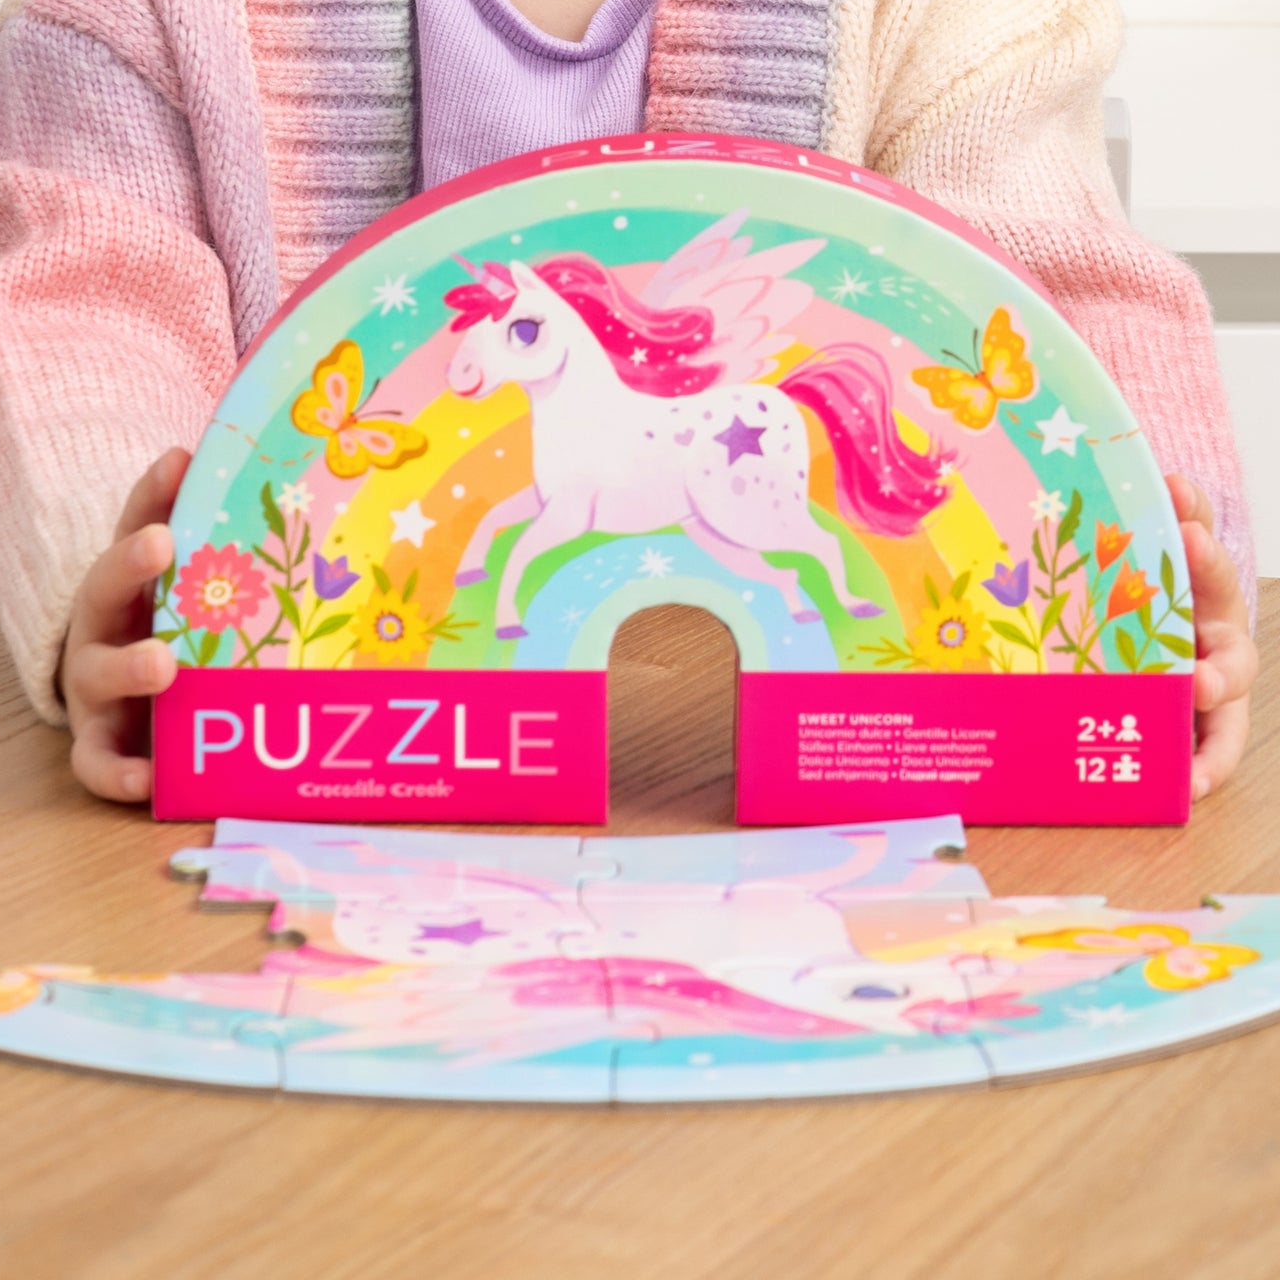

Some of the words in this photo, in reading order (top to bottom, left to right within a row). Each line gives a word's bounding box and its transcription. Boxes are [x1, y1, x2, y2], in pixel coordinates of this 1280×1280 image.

[798, 713, 846, 726] SWEET
[849, 713, 914, 726] UNICORN
[193, 699, 558, 775] PUZZLE
[798, 728, 857, 740] Unicornio
[858, 728, 892, 740] dulce
[903, 728, 949, 740] Gentille
[951, 728, 997, 740] Licorne
[1077, 716, 1115, 742] 2+
[836, 741, 884, 753] Einhorn
[895, 741, 928, 753] Lieve
[929, 741, 987, 753] eenhoorn
[798, 755, 833, 767] Dolce
[901, 755, 933, 767] Doce
[1075, 755, 1106, 782] 12
[296, 778, 386, 798] Crocodile
